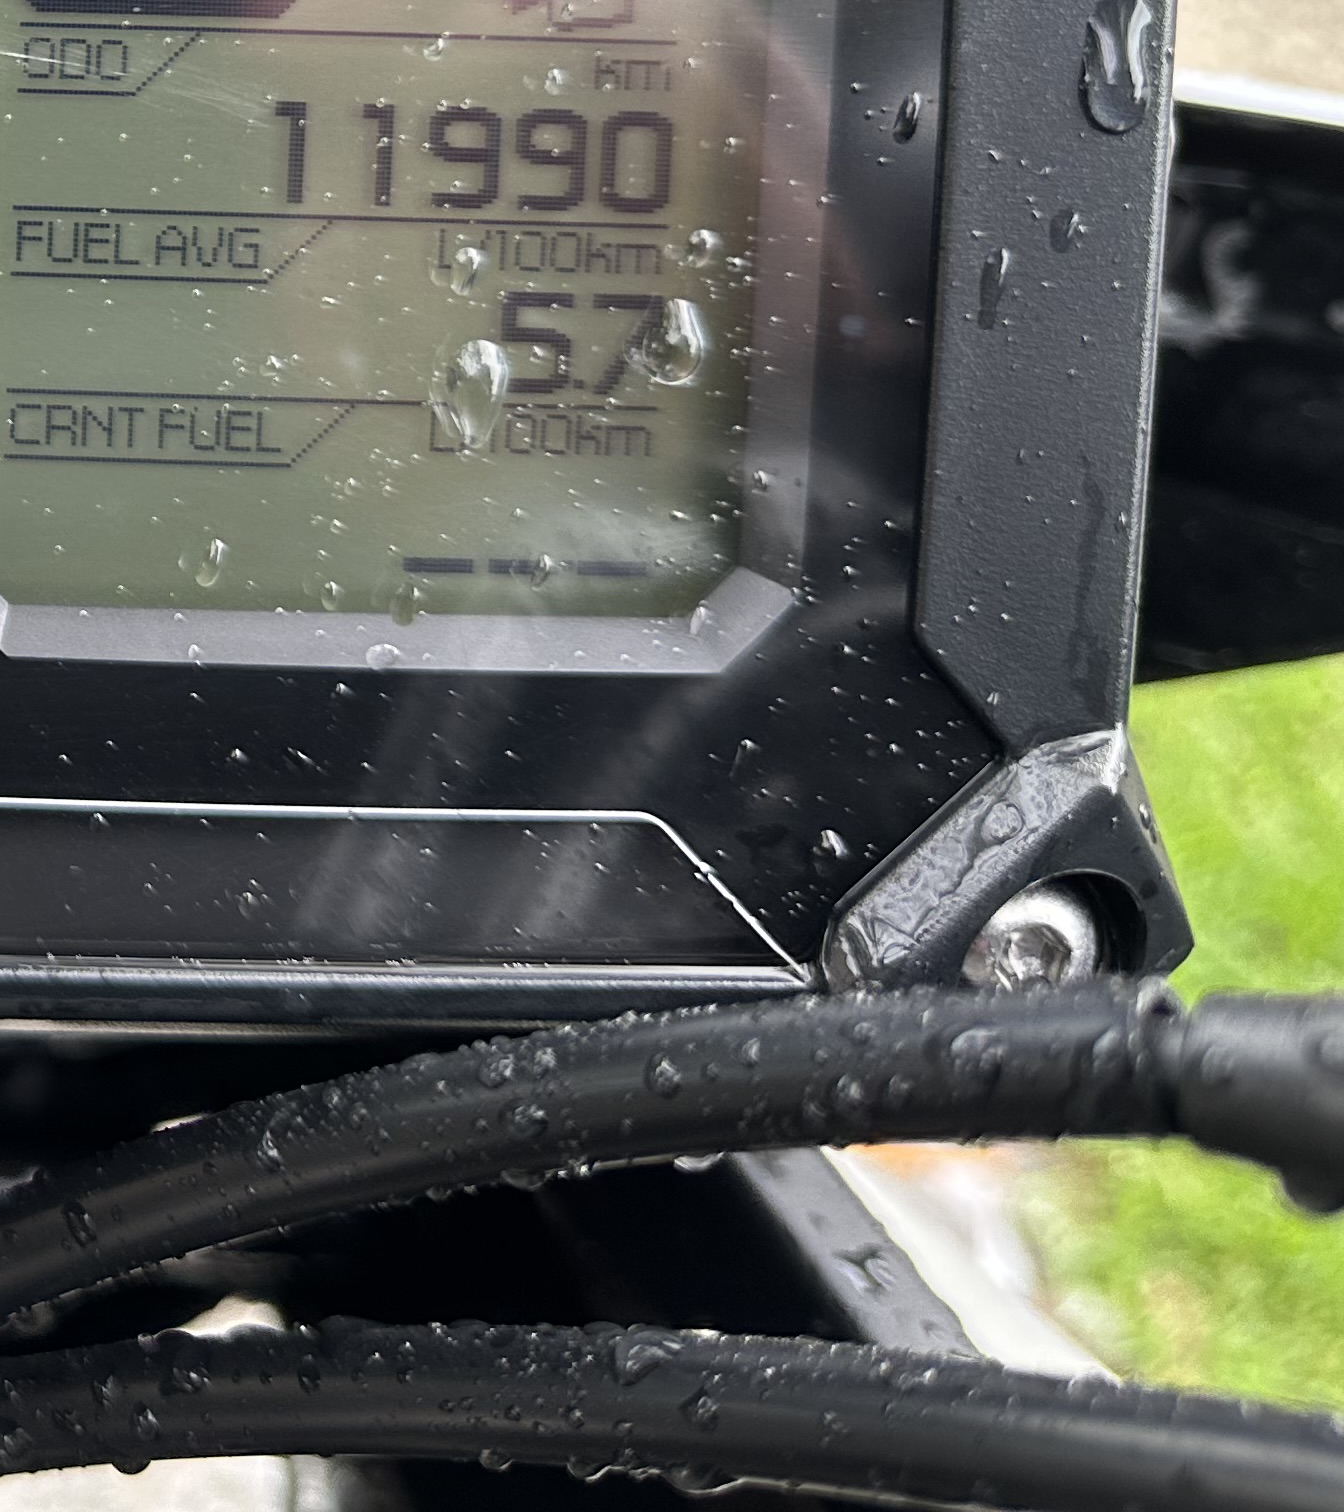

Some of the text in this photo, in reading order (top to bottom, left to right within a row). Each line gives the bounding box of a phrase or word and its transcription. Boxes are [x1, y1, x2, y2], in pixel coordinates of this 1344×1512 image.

[22, 36, 130, 81] ODO
[594, 50, 671, 91] km
[275, 101, 675, 212] 11990
[15, 219, 261, 271] FUEL AVG
[8, 402, 284, 453] CRNT FUEL
[429, 409, 651, 457] L100km
